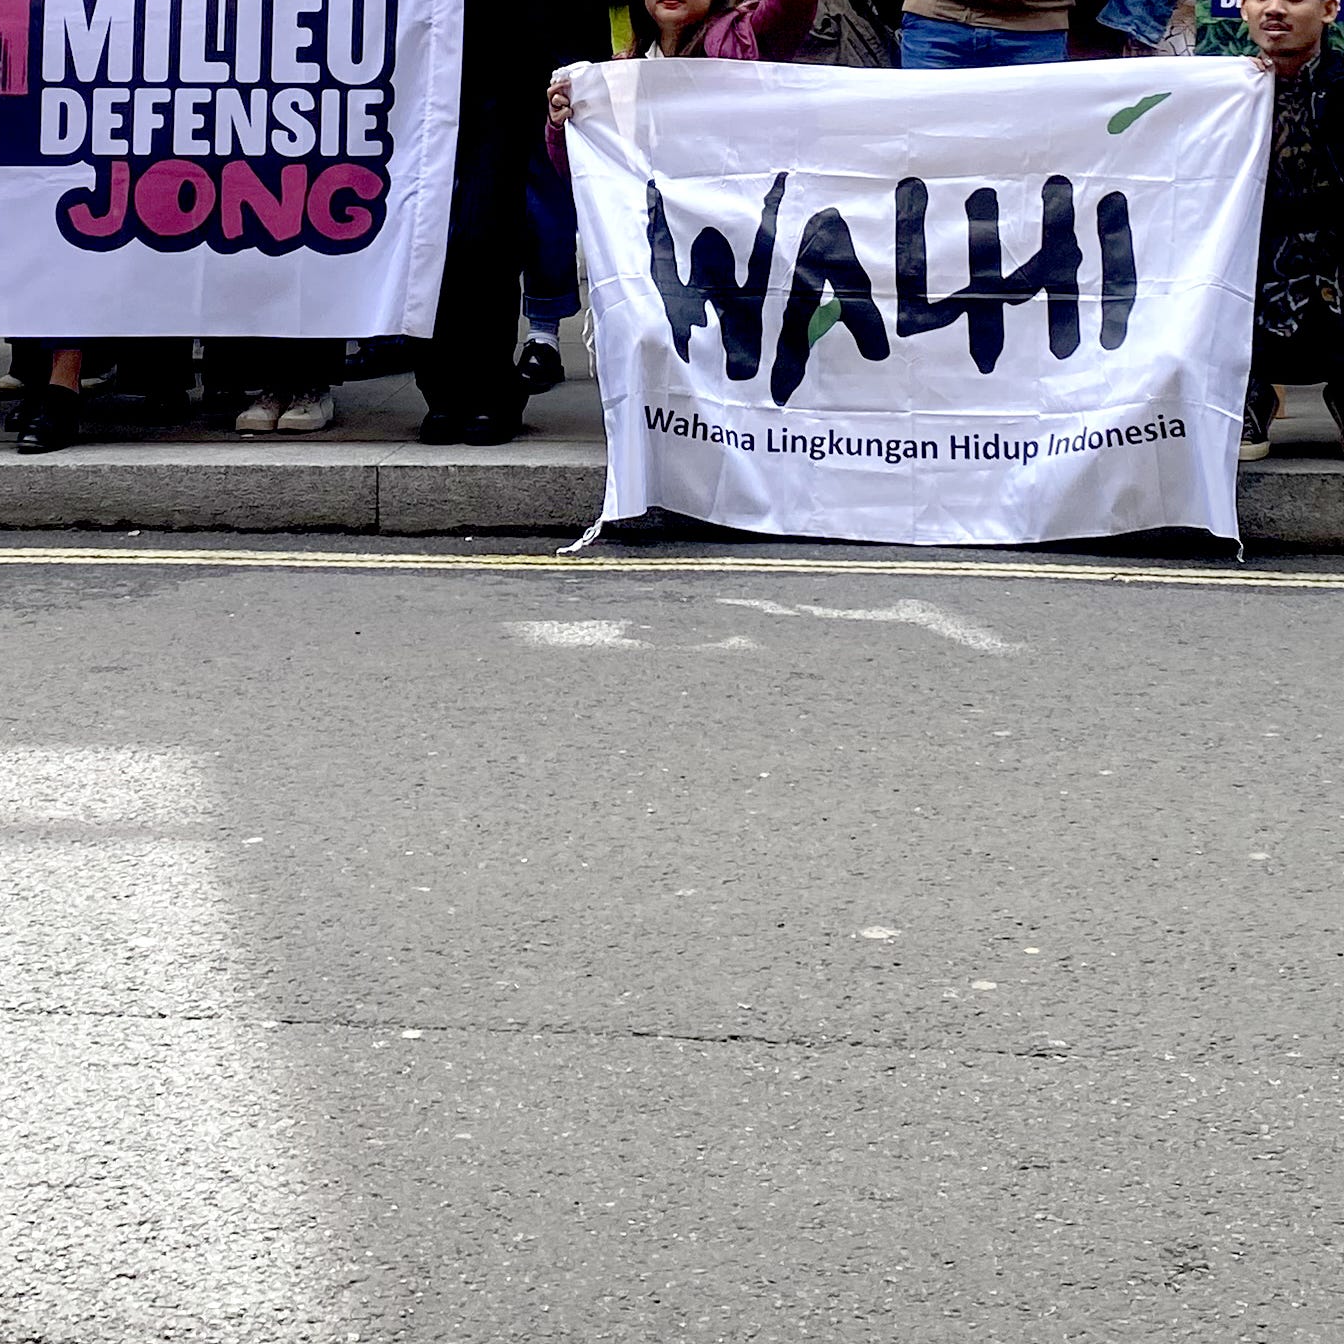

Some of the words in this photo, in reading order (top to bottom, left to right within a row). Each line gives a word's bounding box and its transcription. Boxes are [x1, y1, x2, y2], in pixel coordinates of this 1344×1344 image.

[39, 87, 384, 157] DEFENSIE
[67, 159, 385, 242] JONG
[646, 171, 1139, 406] WALHI
[644, 405, 757, 453] Wahana
[766, 426, 938, 464] Lingkungan
[950, 432, 1040, 466] Hidup
[1047, 413, 1187, 459] Indonesia
